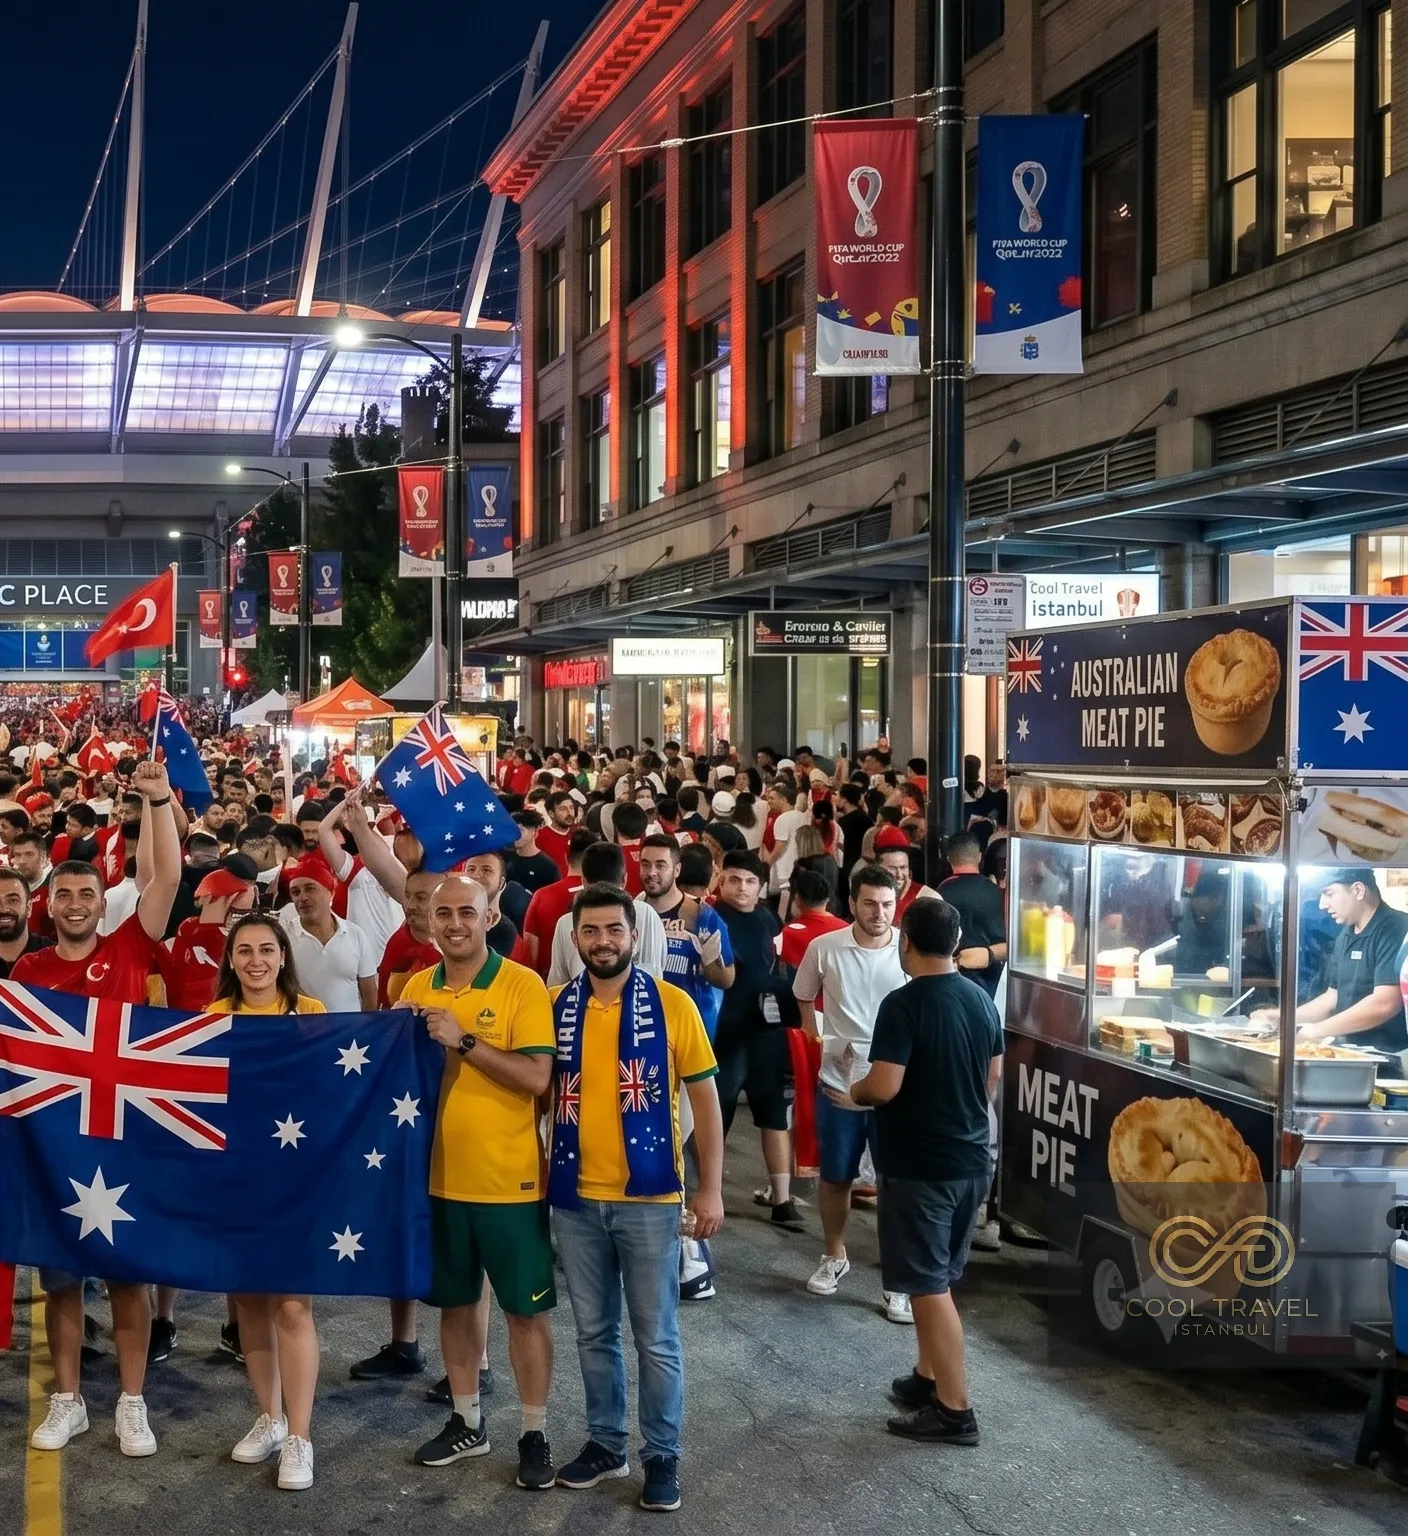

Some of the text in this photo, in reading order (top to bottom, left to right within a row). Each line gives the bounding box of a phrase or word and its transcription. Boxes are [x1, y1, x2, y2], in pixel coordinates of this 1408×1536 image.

[886, 243, 905, 252] CUP
[24, 584, 109, 606] PLACE
[1030, 581, 1103, 595] Cool Travel
[1032, 600, 1103, 617] istanbul
[1070, 651, 1178, 699] AUSTRALIAN
[1081, 706, 1166, 748] MEAT PIE
[1017, 1062, 1100, 1140] MEAT
[1031, 1128, 1077, 1198] PIE
